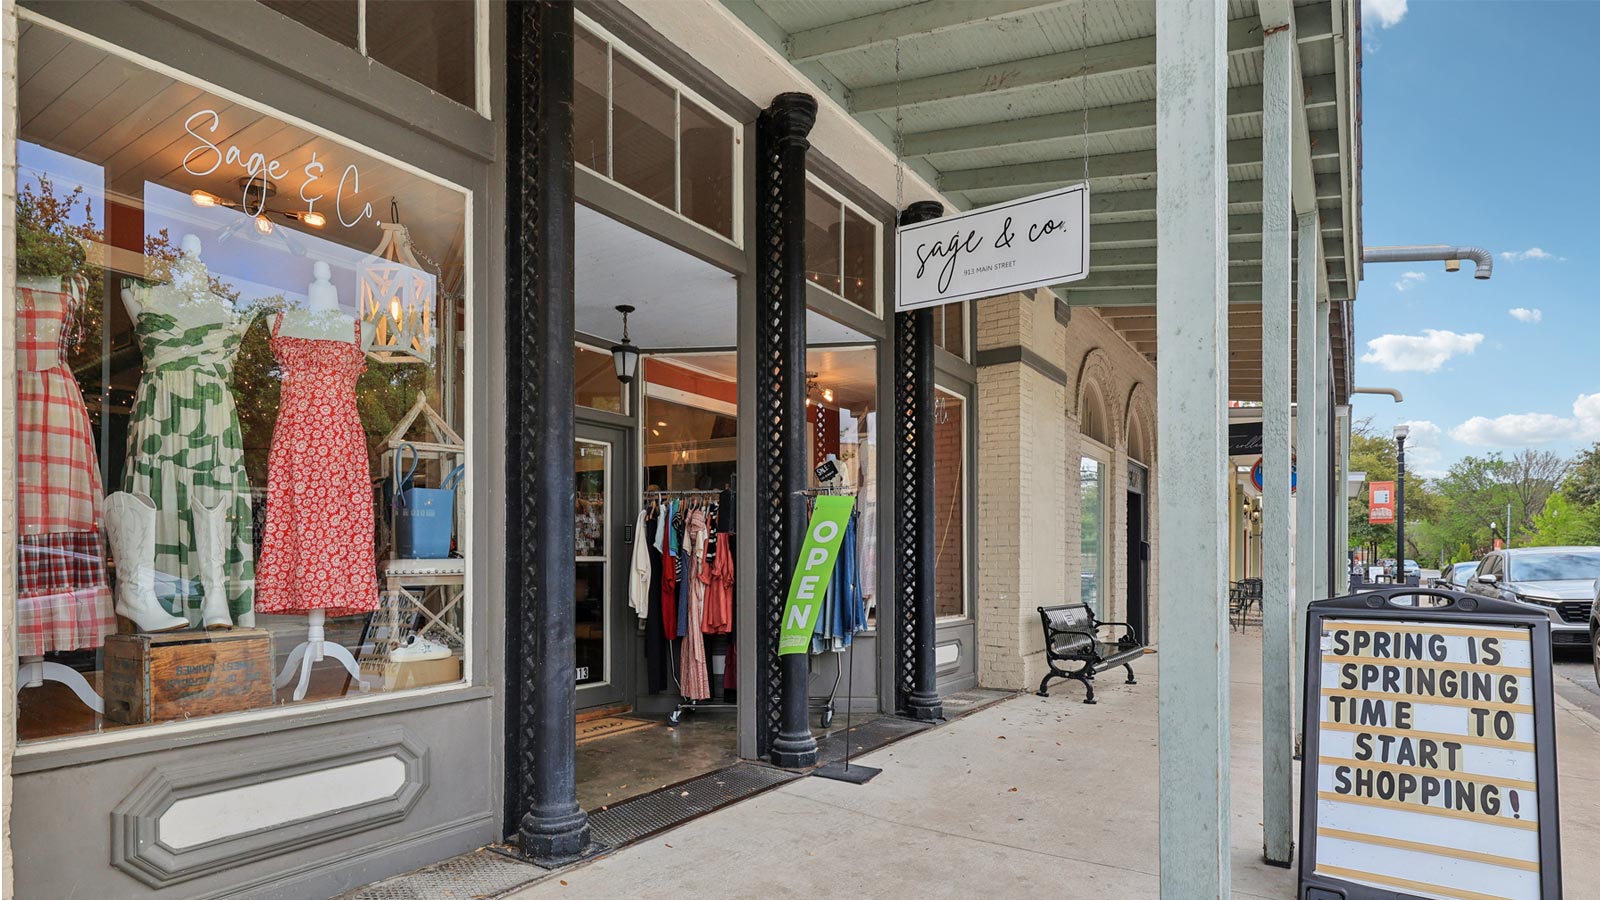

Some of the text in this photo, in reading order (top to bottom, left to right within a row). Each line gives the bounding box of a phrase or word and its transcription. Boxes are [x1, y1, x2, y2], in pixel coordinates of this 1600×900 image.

[183, 110, 381, 228] Sage & Co.
[916, 216, 1067, 294] sage & co.
[963, 260, 1017, 277] 913 MAIN STREET
[786, 520, 838, 630] OPEN
[1333, 630, 1502, 666] SPRING IS
[1341, 663, 1519, 704] SPRINGING
[1329, 695, 1515, 741] TIME TO
[1354, 732, 1462, 772] START
